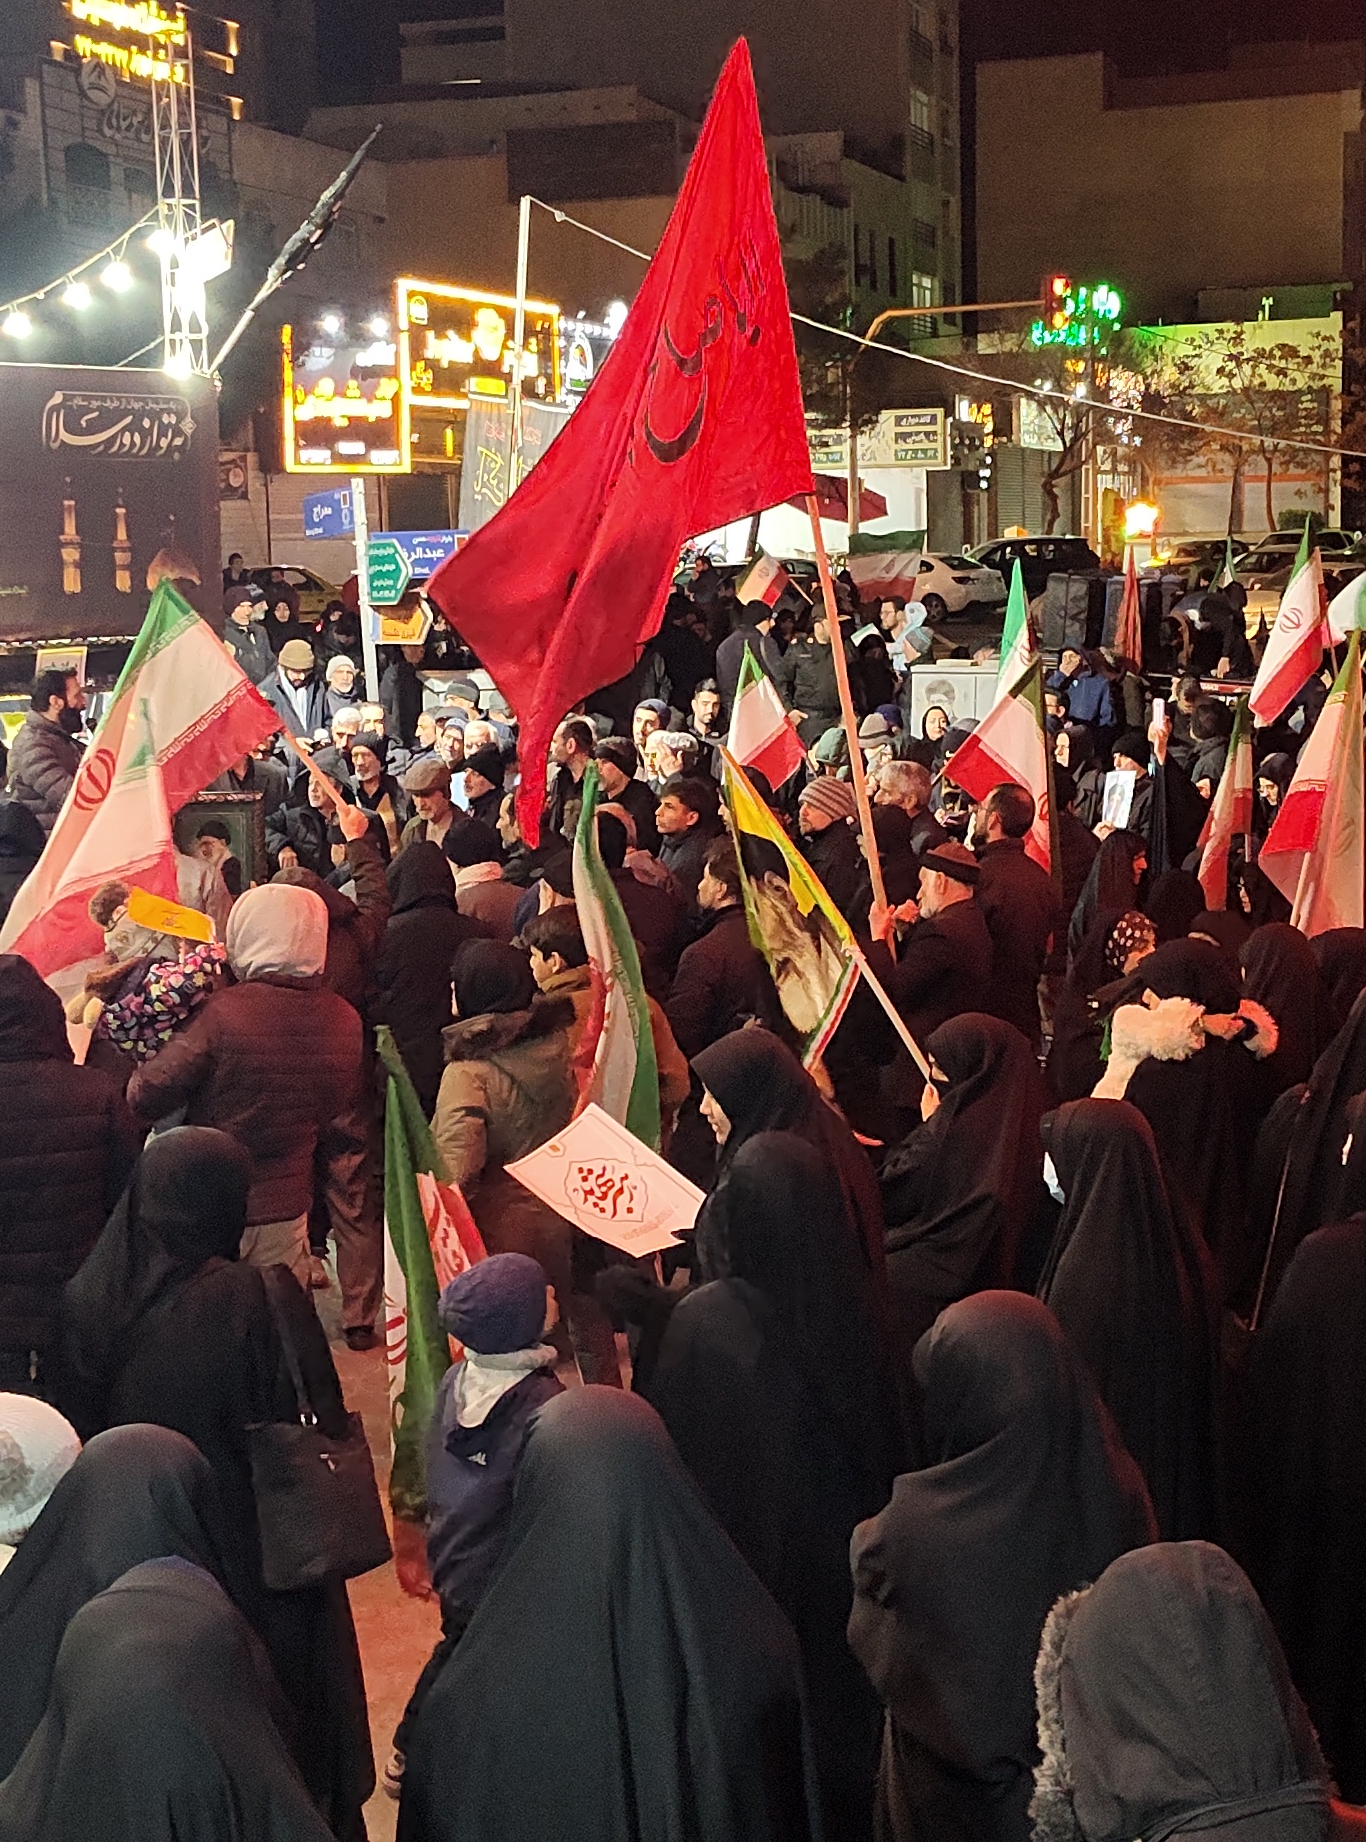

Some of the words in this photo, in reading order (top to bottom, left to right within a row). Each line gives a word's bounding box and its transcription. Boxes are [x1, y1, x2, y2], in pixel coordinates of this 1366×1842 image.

[42, 390, 134, 456] سلام
[108, 431, 141, 455] دور
[139, 417, 158, 456] از
[156, 412, 177, 456] تو
